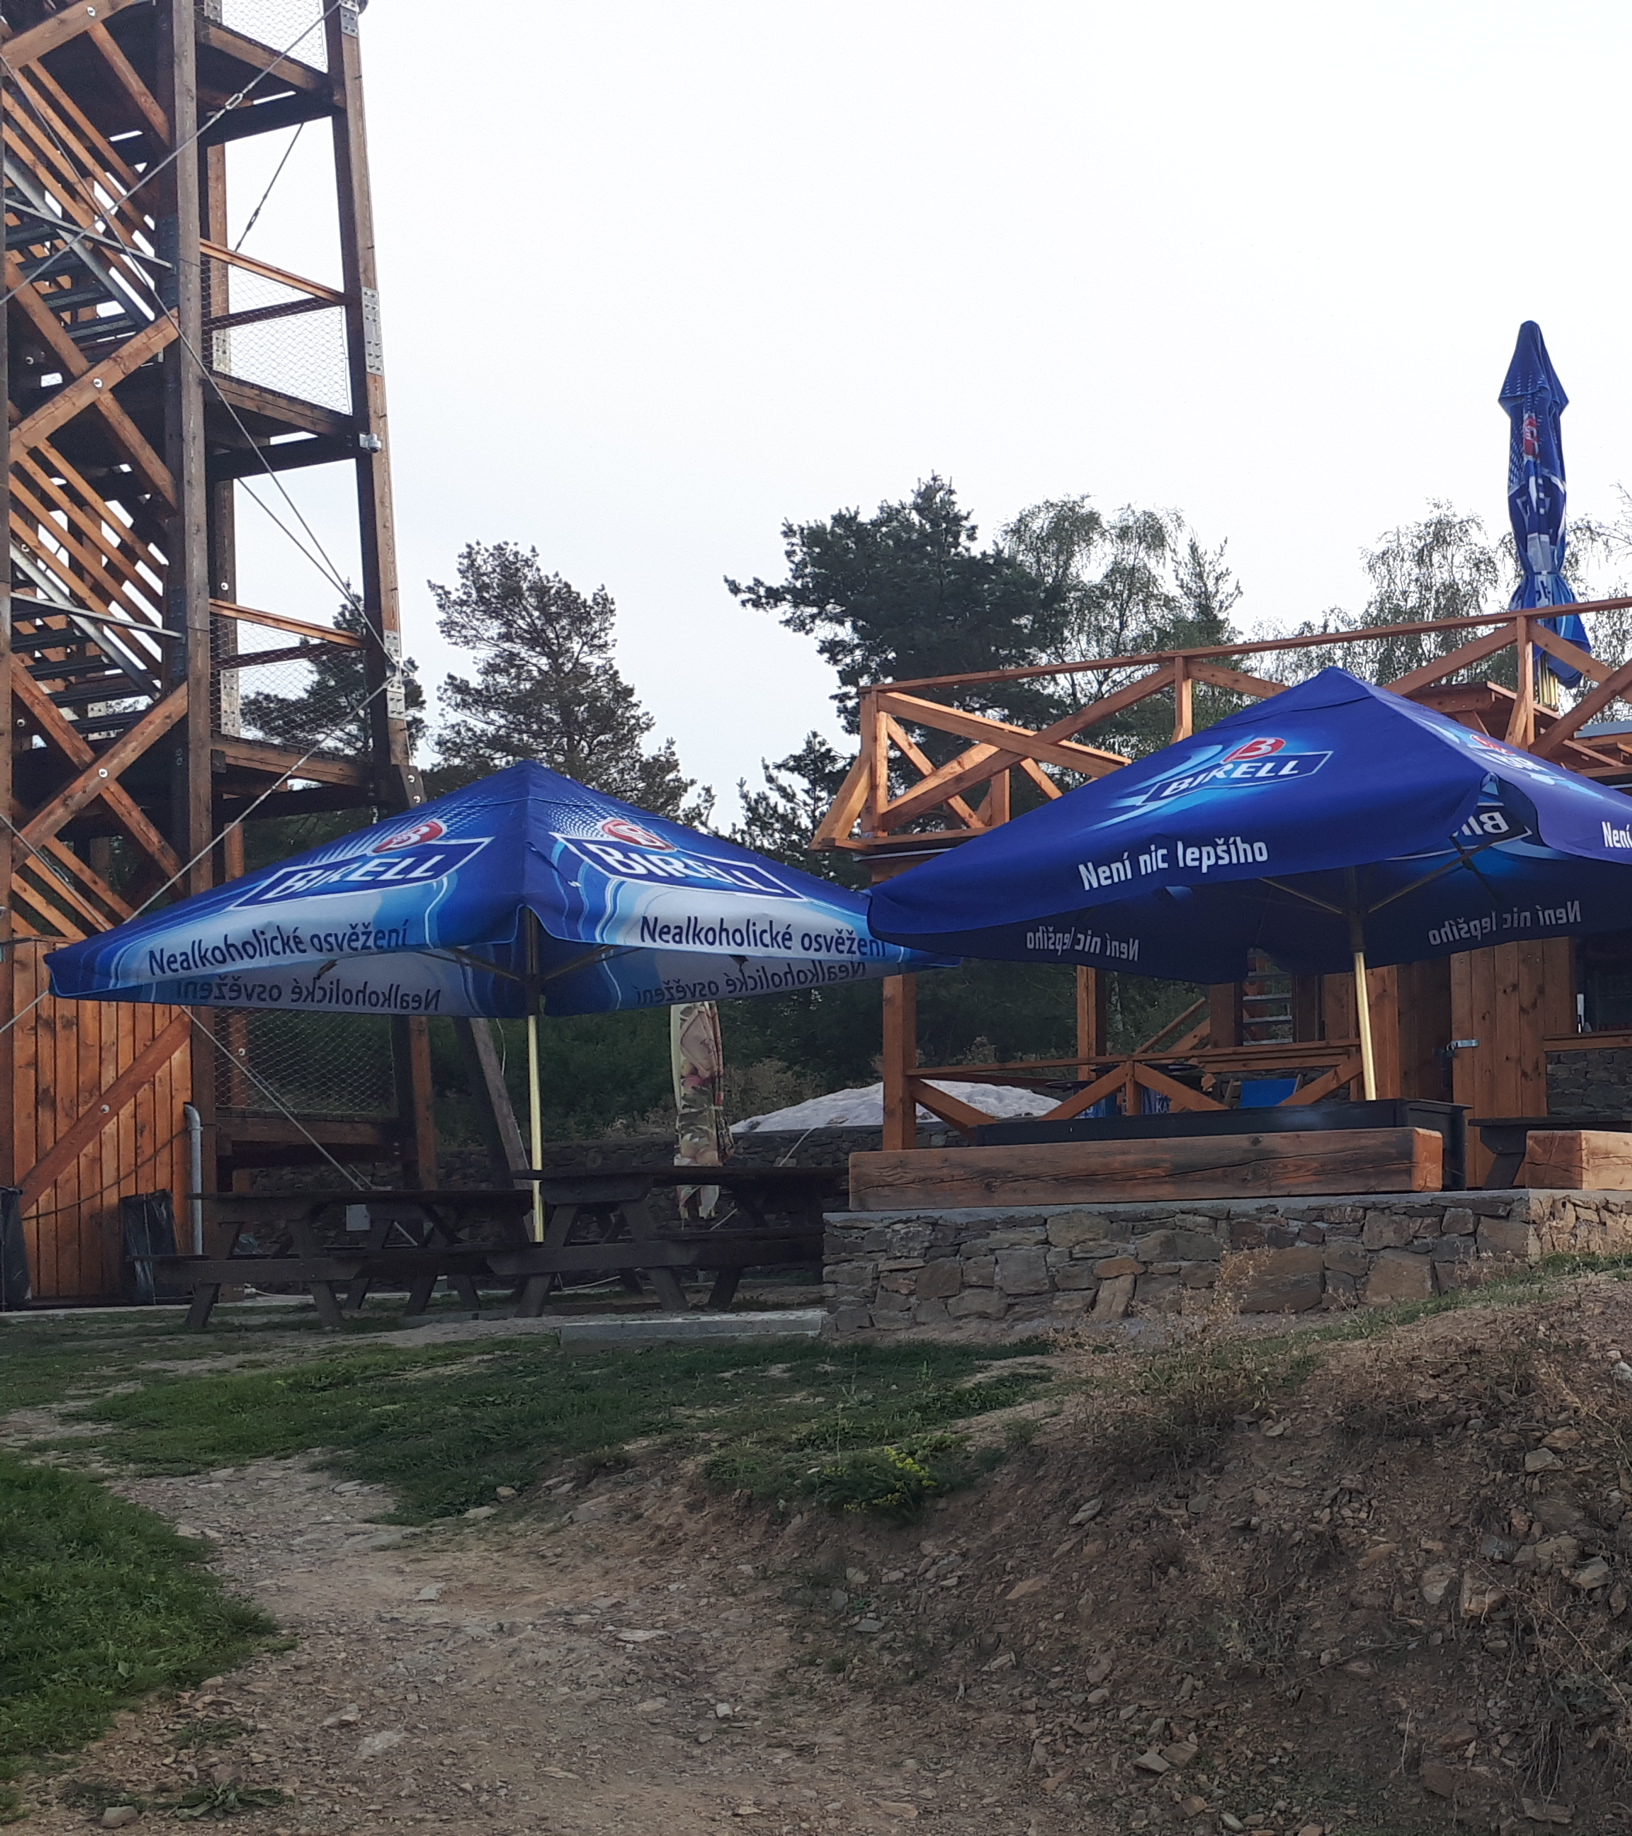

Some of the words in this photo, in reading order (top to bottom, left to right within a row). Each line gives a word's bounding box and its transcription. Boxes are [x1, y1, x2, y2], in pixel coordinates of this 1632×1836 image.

[1159, 760, 1299, 798] BIRELL
[259, 854, 446, 901] BIRELL
[582, 842, 785, 894] BIRELL
[1078, 852, 1132, 891] Není
[1140, 844, 1168, 875] nic
[1177, 836, 1269, 873] lepšího
[149, 924, 305, 977] Nealkoholické
[311, 919, 409, 953] osvěžení
[640, 916, 793, 951] Nealkoholické
